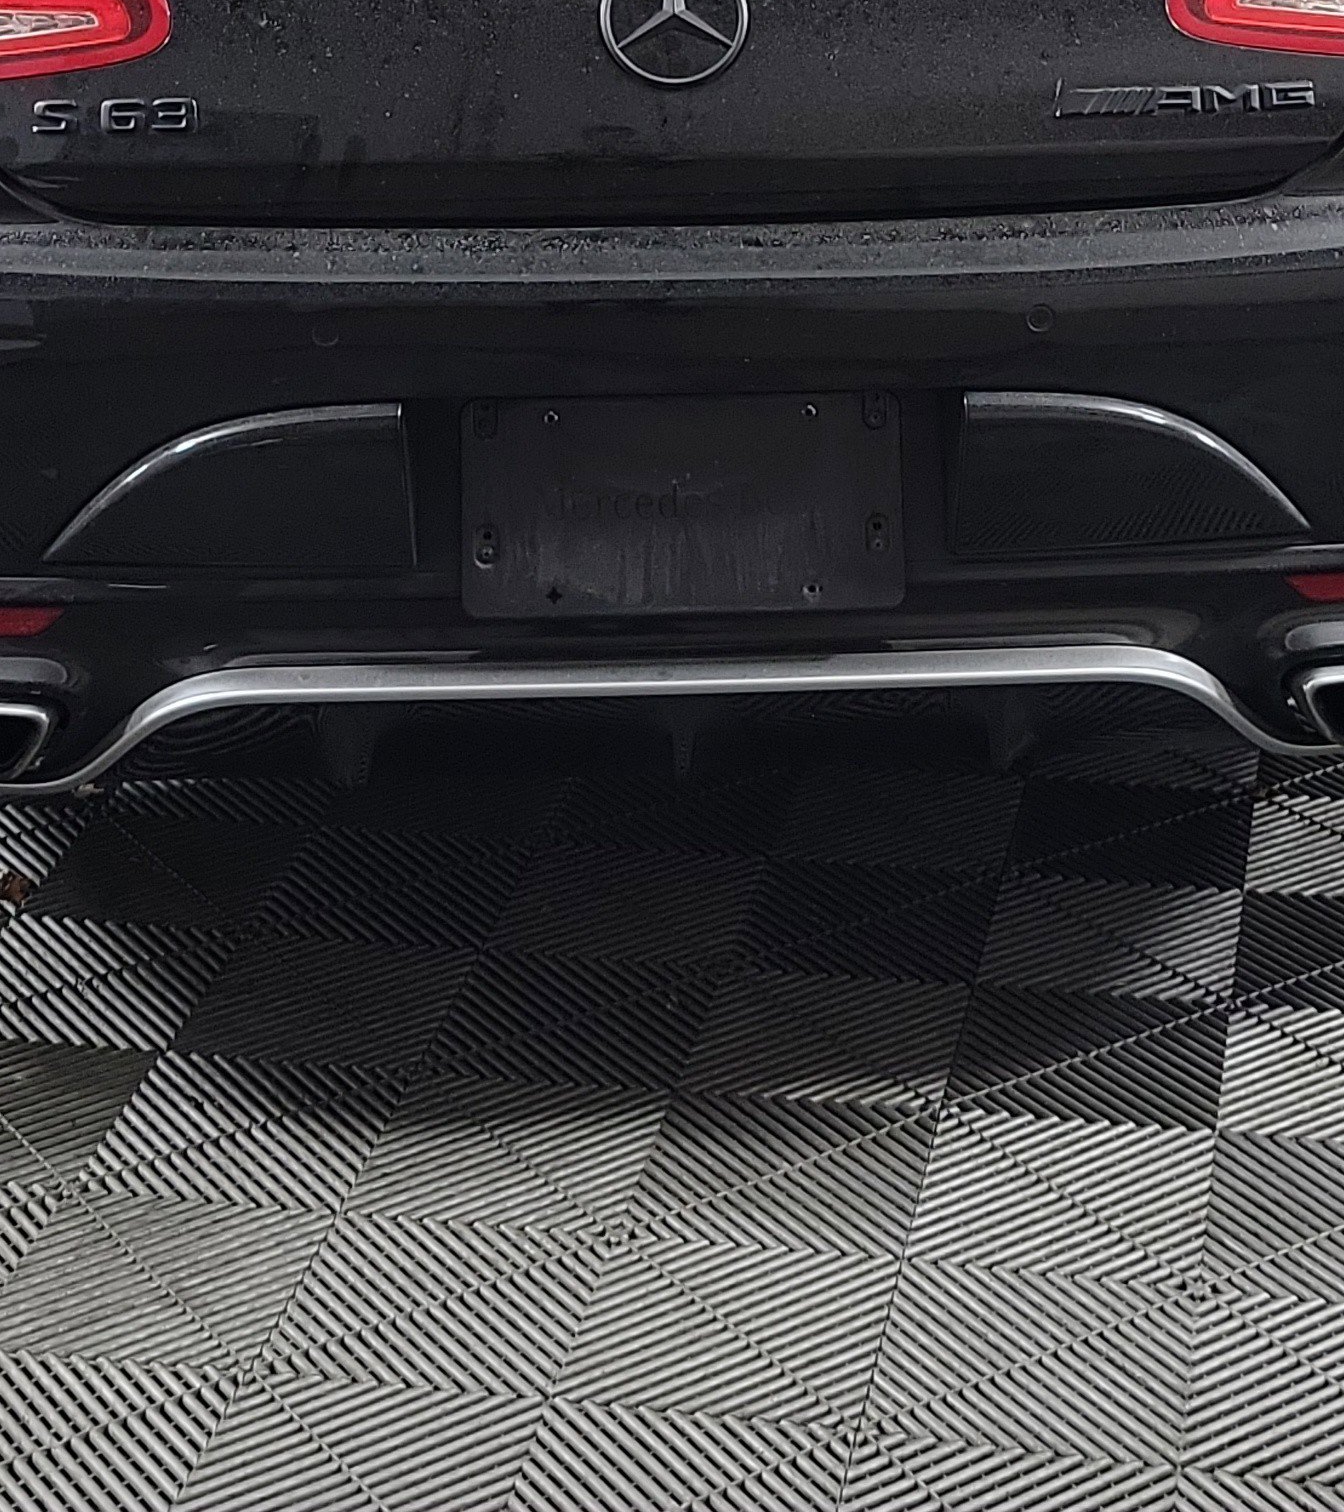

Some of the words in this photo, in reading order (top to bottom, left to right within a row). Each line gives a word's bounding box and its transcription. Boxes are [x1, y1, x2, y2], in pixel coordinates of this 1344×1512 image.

[31, 98, 78, 133] S
[100, 96, 199, 133] 63
[1156, 80, 1316, 115] AMG
